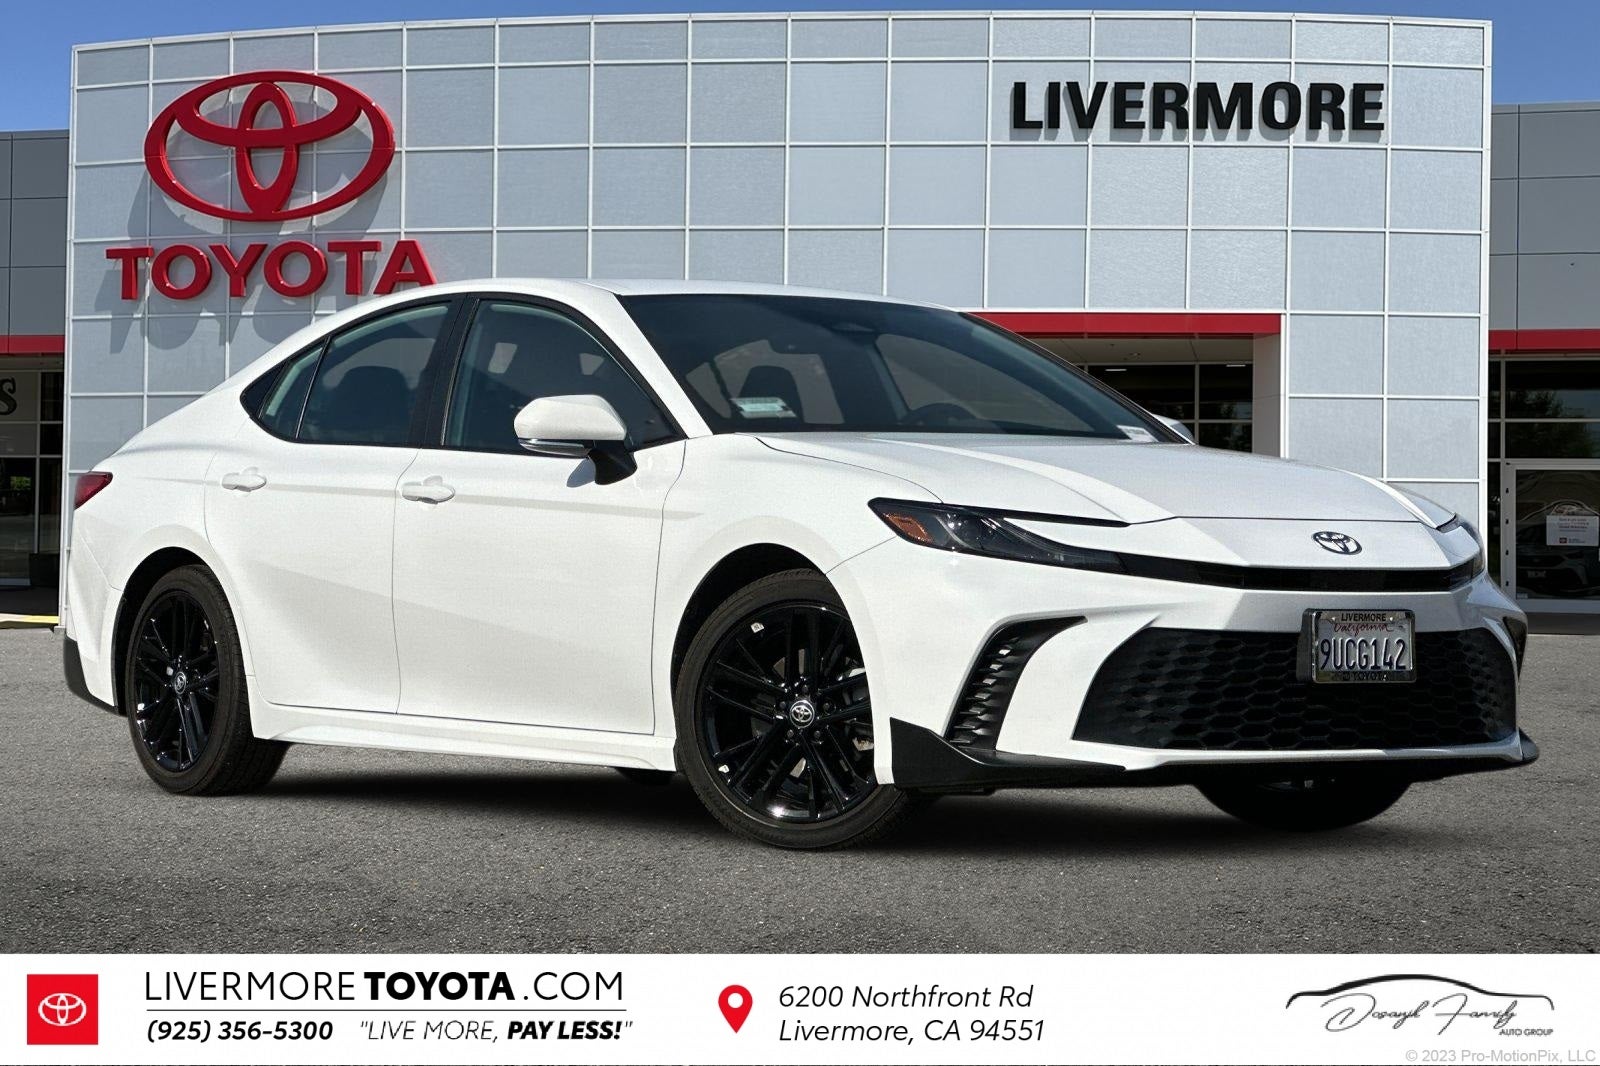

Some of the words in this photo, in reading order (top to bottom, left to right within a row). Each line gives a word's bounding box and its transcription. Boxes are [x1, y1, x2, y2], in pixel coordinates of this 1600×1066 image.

[1012, 81, 1386, 131] LIVERMORE
[106, 239, 437, 300] TOYOTA
[1334, 622, 1394, 637] California
[1341, 613, 1387, 622] LIVERMORE
[1320, 637, 1407, 671] 9UCG142
